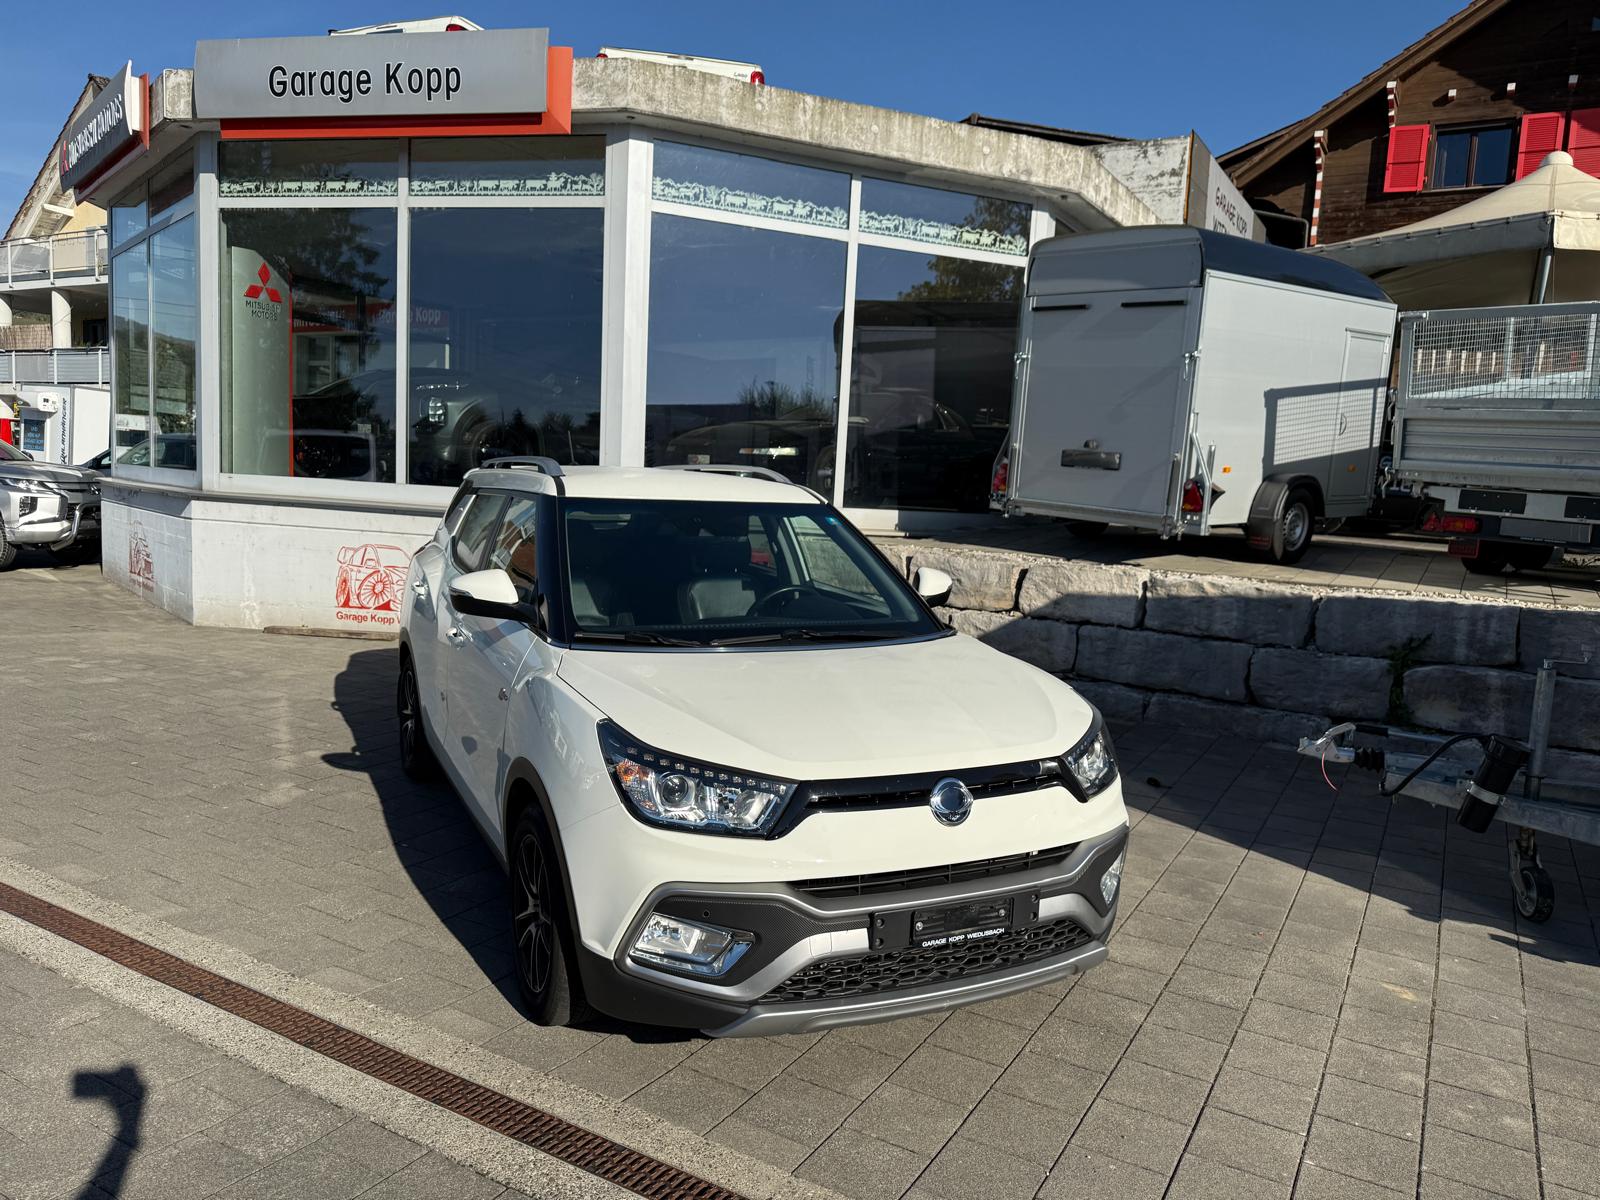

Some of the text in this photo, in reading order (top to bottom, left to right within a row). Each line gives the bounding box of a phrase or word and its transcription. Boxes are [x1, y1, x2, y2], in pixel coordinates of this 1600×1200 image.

[268, 62, 461, 103] Garage Kopp
[336, 611, 368, 623] Garage
[370, 613, 395, 625] Kopp
[922, 938, 947, 948] GARAGE
[948, 934, 965, 943] KOPP
